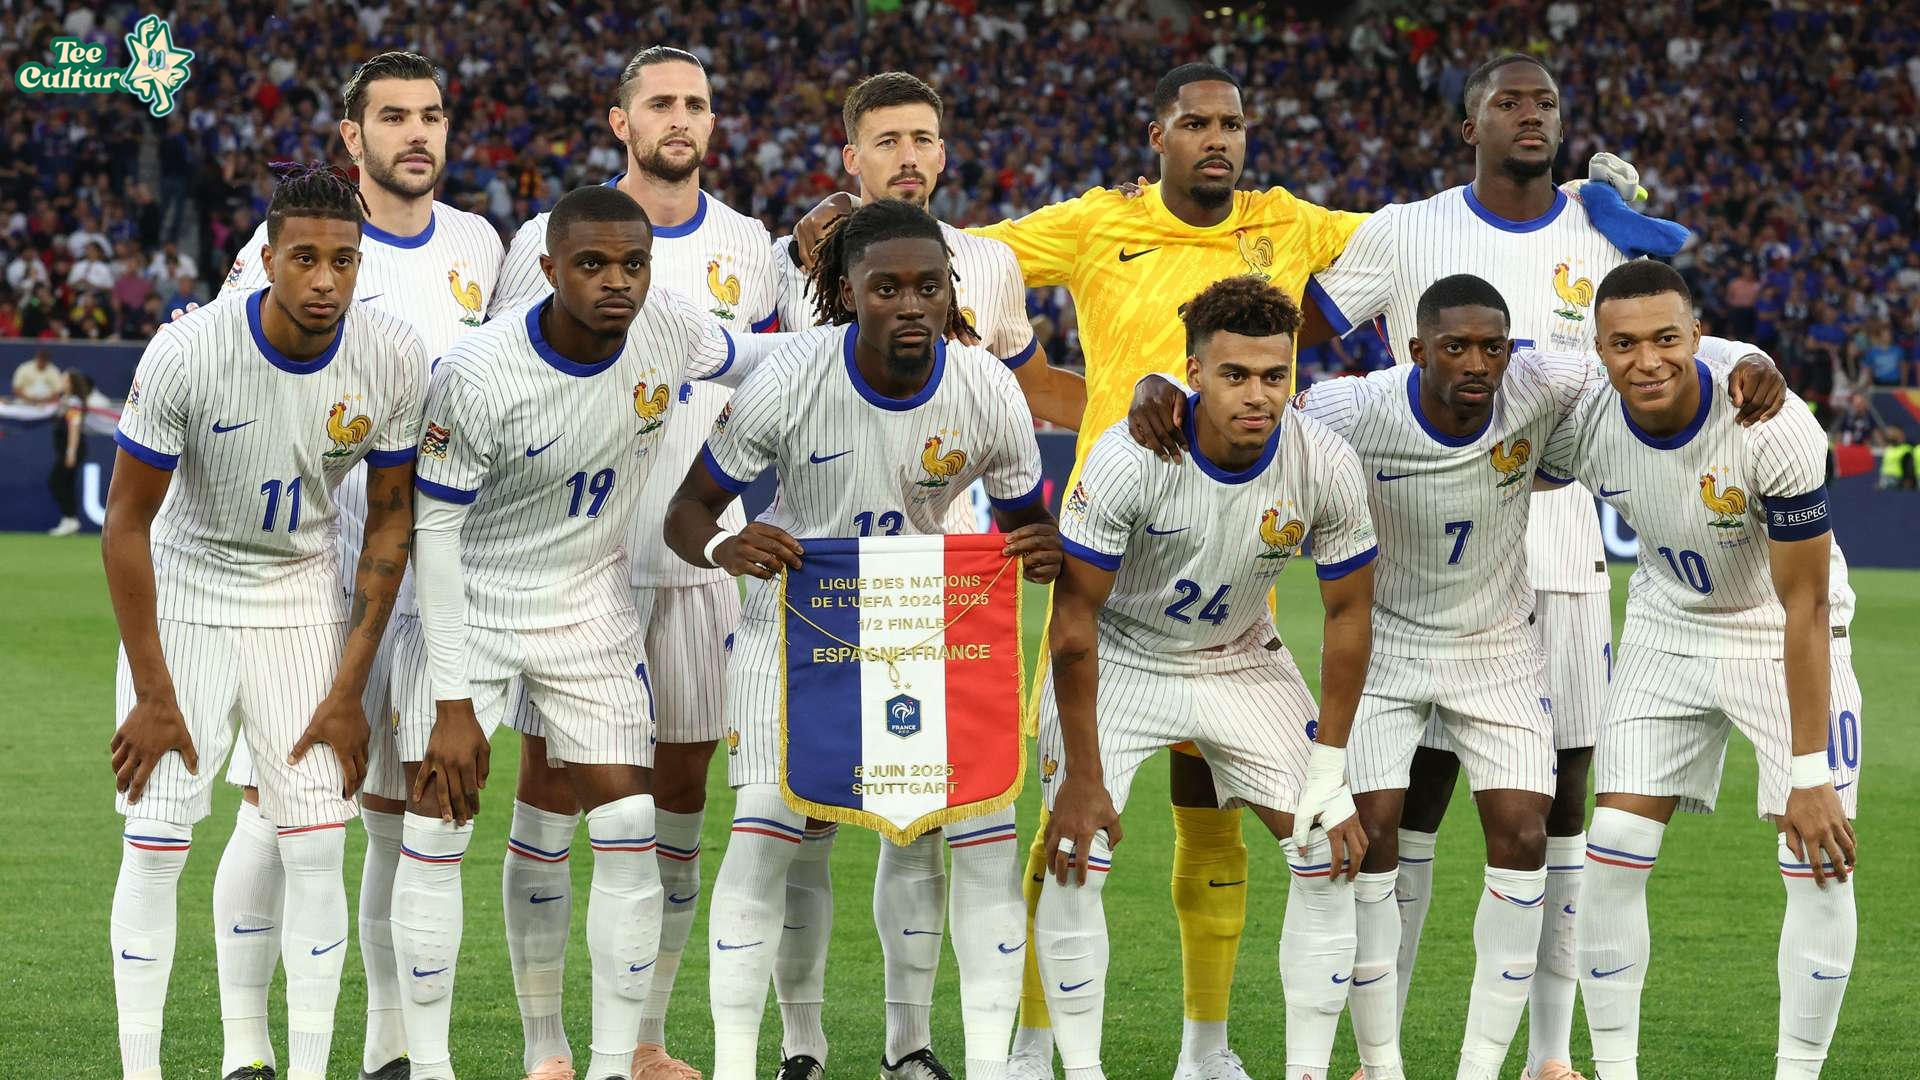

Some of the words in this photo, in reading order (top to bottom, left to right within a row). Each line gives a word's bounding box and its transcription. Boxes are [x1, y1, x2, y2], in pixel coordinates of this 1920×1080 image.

[566, 467, 616, 518] 19
[261, 476, 302, 533] 11
[1788, 504, 1827, 523] RESPECT
[1444, 520, 1473, 565] 7
[1658, 546, 1714, 596] 10
[819, 577, 868, 590] LIGUE
[872, 577, 904, 590] DES
[910, 575, 981, 588] NATIONS
[811, 596, 833, 608] DE
[838, 595, 893, 608] L'UEFA
[899, 593, 989, 607] 2024-2025
[1164, 579, 1232, 626] 24
[857, 618, 883, 631] 1/2
[888, 617, 945, 630] FINALE
[854, 765, 864, 778] 5
[869, 765, 905, 778] JUIN
[910, 764, 955, 777] 2025
[852, 782, 958, 796] STUTTGART
